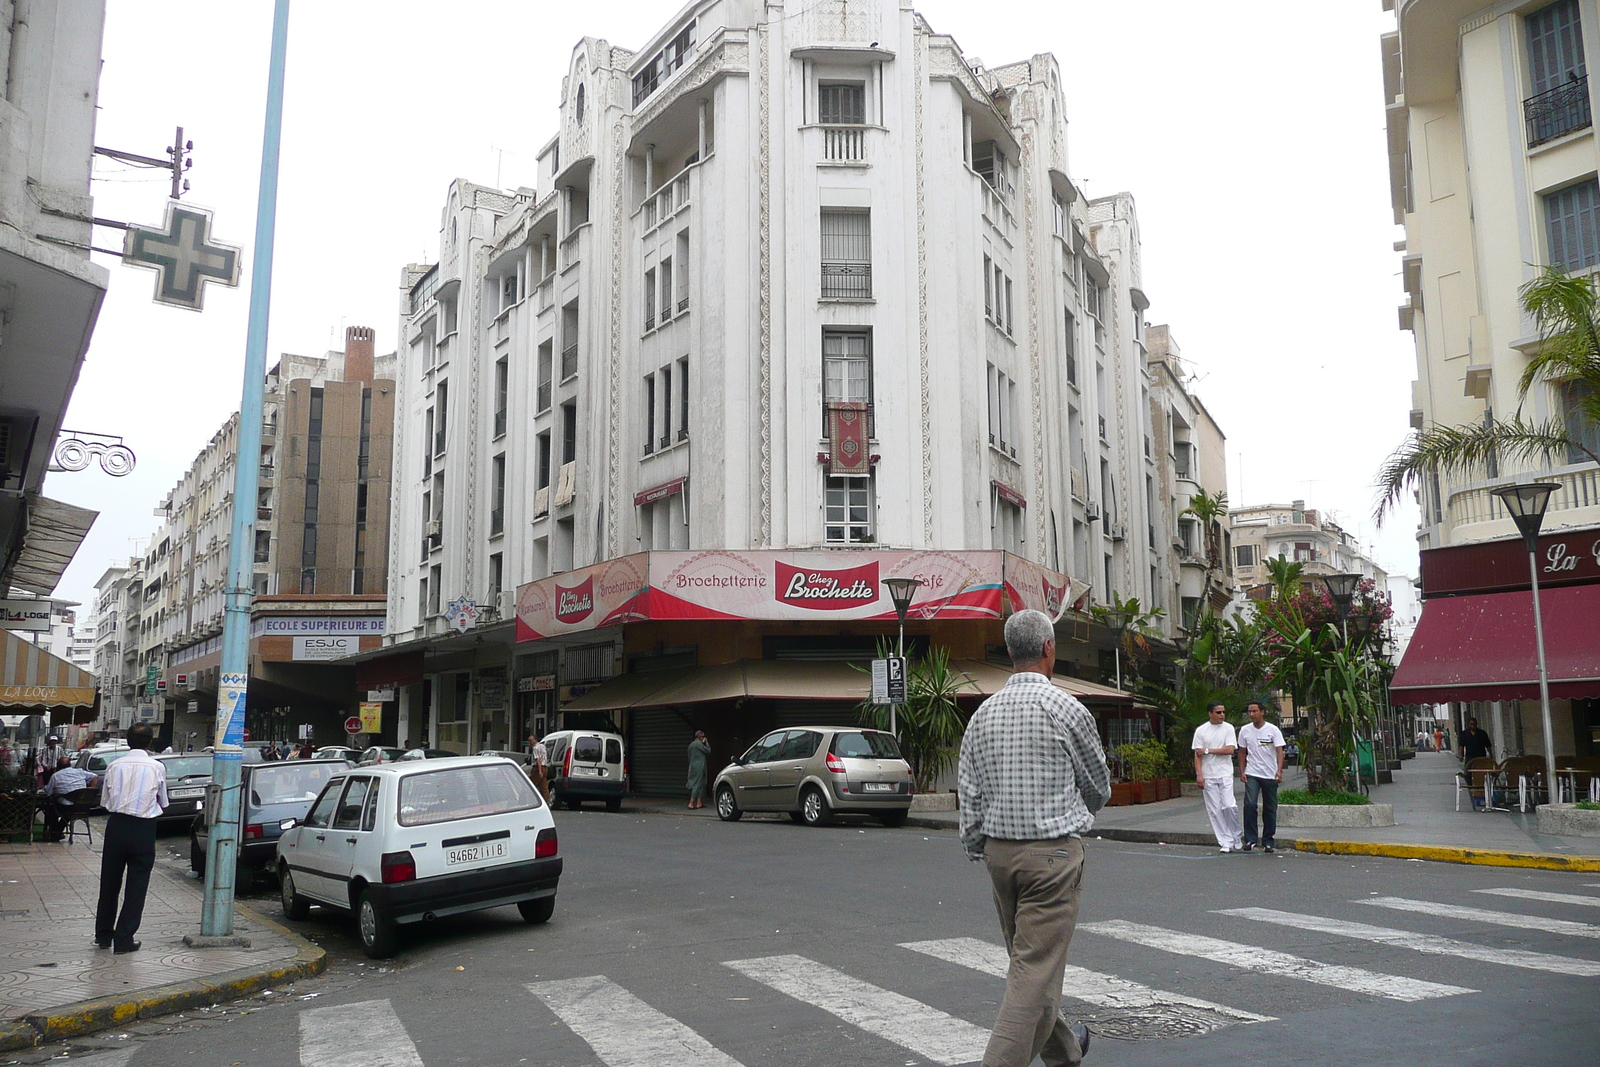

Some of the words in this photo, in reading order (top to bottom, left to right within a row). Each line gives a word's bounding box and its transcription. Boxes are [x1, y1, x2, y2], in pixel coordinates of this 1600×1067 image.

[1543, 543, 1577, 573] La
[676, 574, 767, 588] Brochetterie
[784, 572, 873, 599] Brochette
[808, 573, 833, 587] Chez
[600, 580, 640, 598] Brochetterie
[559, 592, 592, 616] Brochette
[266, 621, 298, 630] ECOLE
[300, 621, 368, 630] SUPERIEURE
[370, 621, 384, 630] DE
[305, 639, 347, 647] ESJC
[890, 659, 901, 680] P
[4, 687, 20, 698] LA
[24, 688, 58, 700] LOGE
[450, 847, 479, 863] 94662
